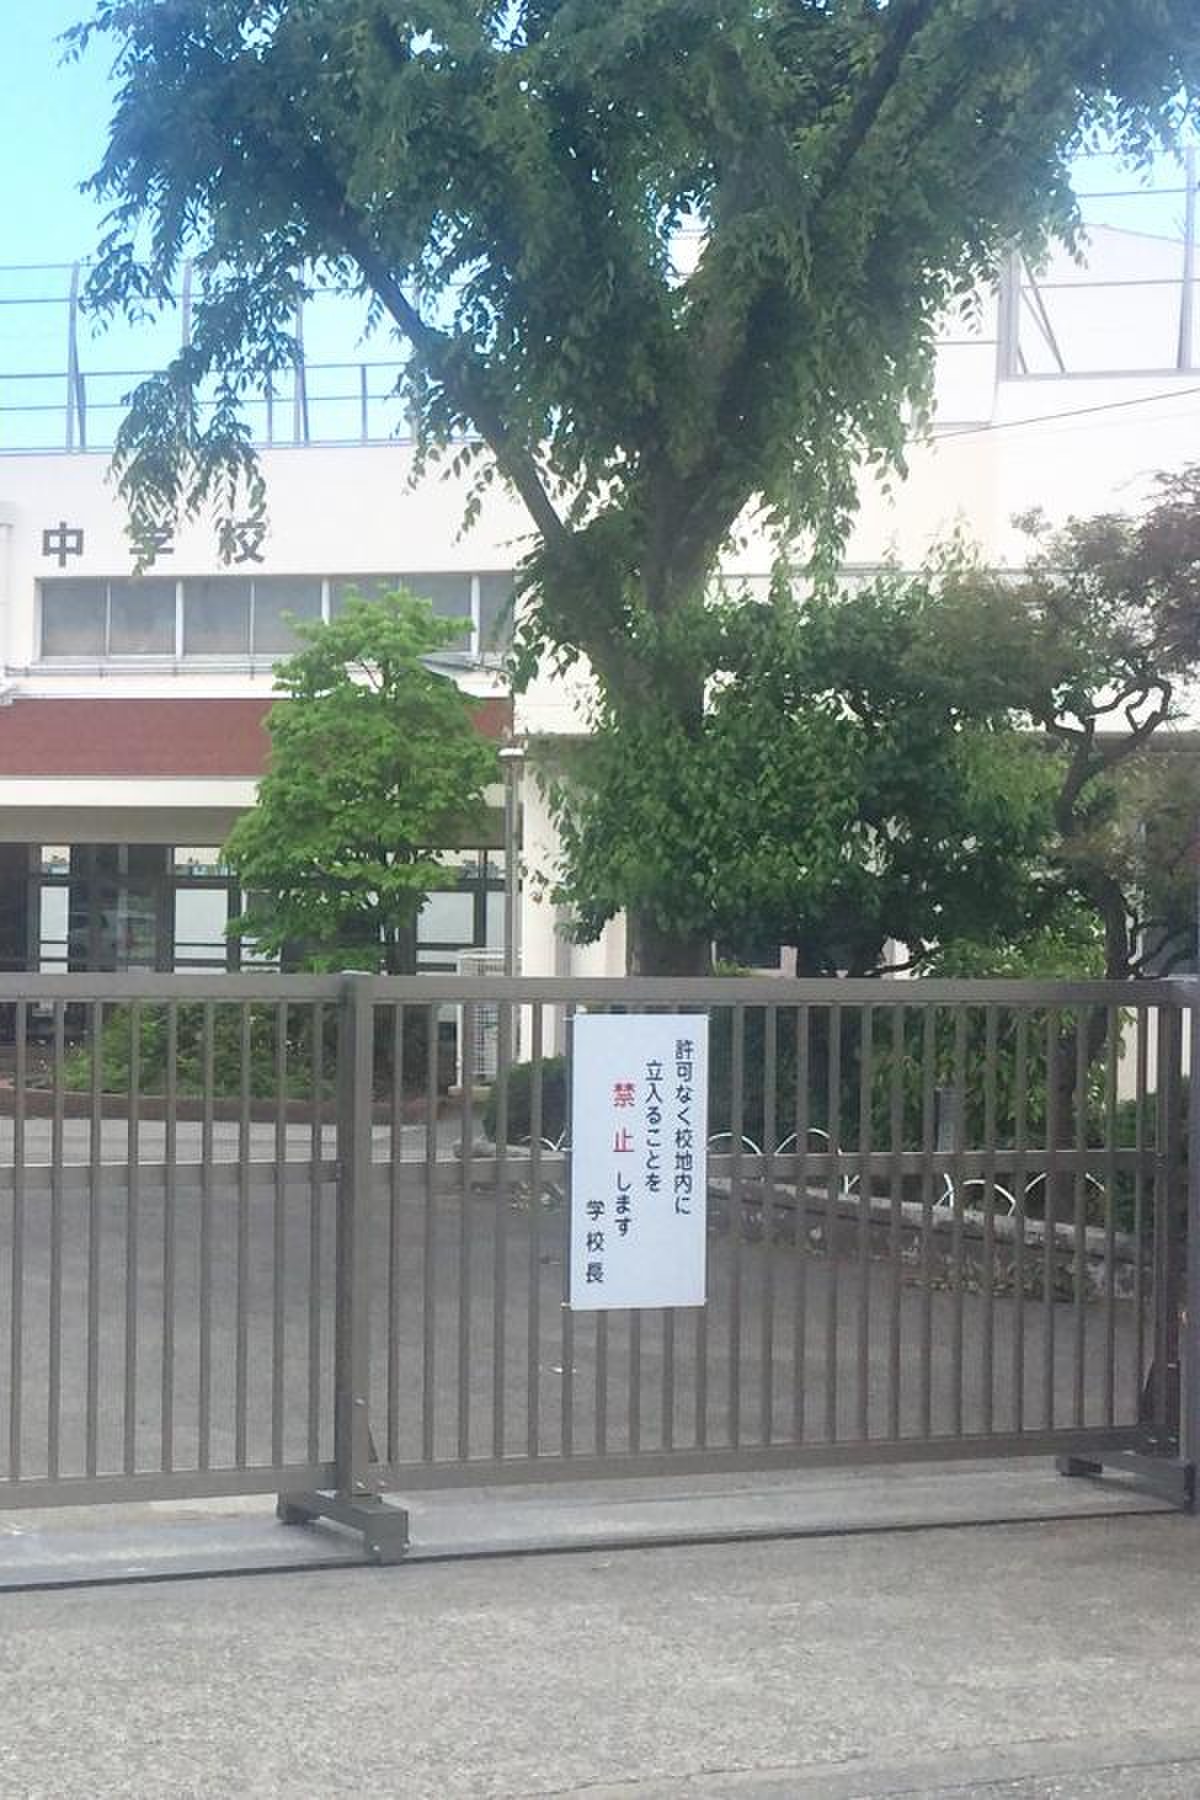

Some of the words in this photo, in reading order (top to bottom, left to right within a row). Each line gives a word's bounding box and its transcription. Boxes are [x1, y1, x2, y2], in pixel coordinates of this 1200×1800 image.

[644, 1060, 664, 1194] 立入ることを
[674, 1039, 694, 1216] 許可なく校地内に
[585, 1200, 606, 1284] 学校長
